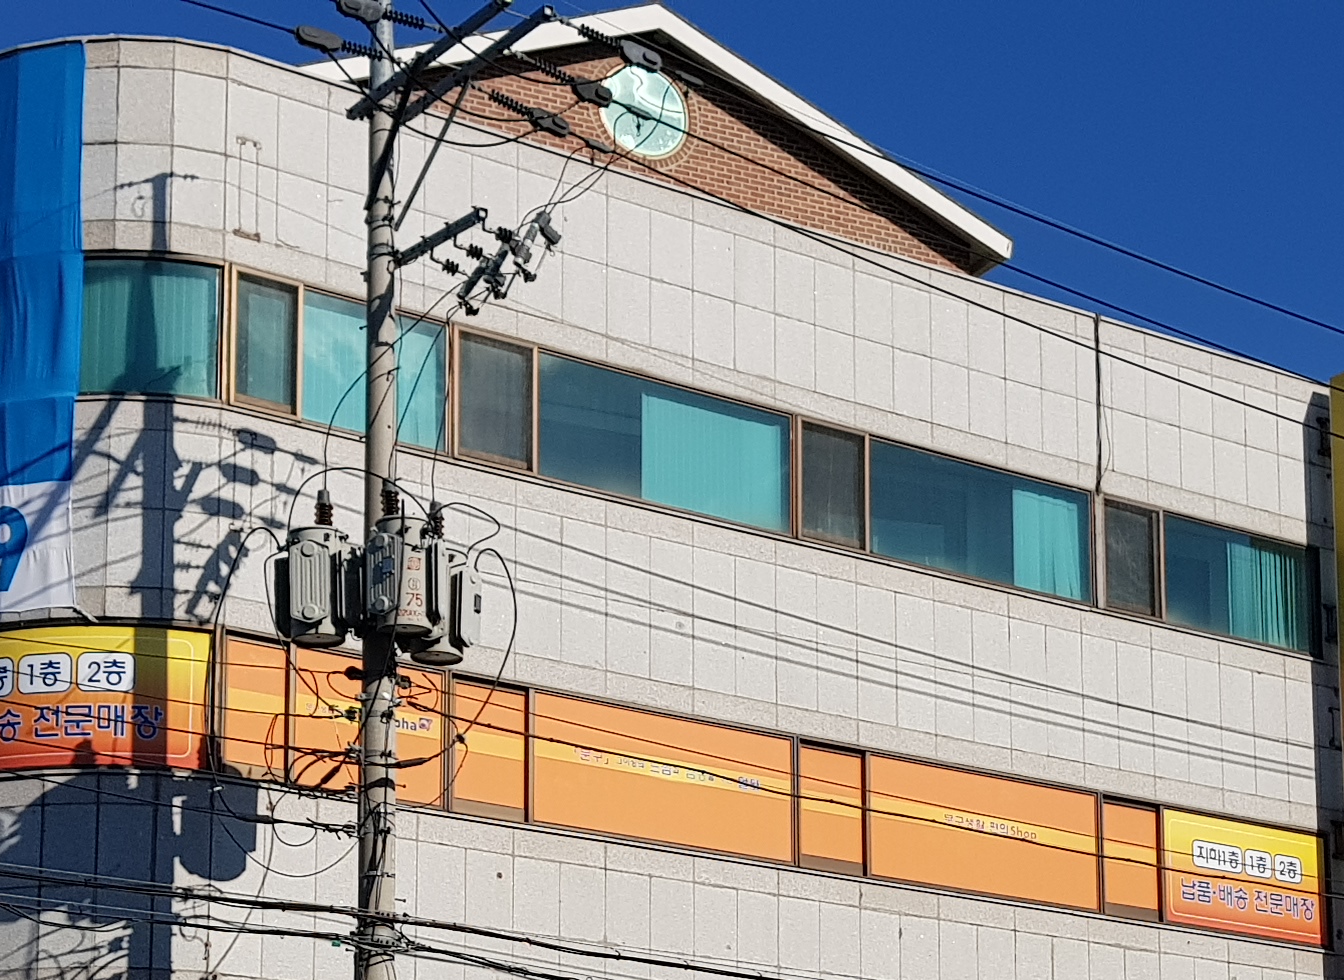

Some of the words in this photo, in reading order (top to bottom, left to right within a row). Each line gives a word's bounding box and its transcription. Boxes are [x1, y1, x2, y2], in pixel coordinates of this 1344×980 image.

[27, 659, 65, 689] 1층
[87, 658, 126, 686] 2층
[32, 705, 165, 741] 전문매장
[1254, 889, 1316, 922] 전문매장
